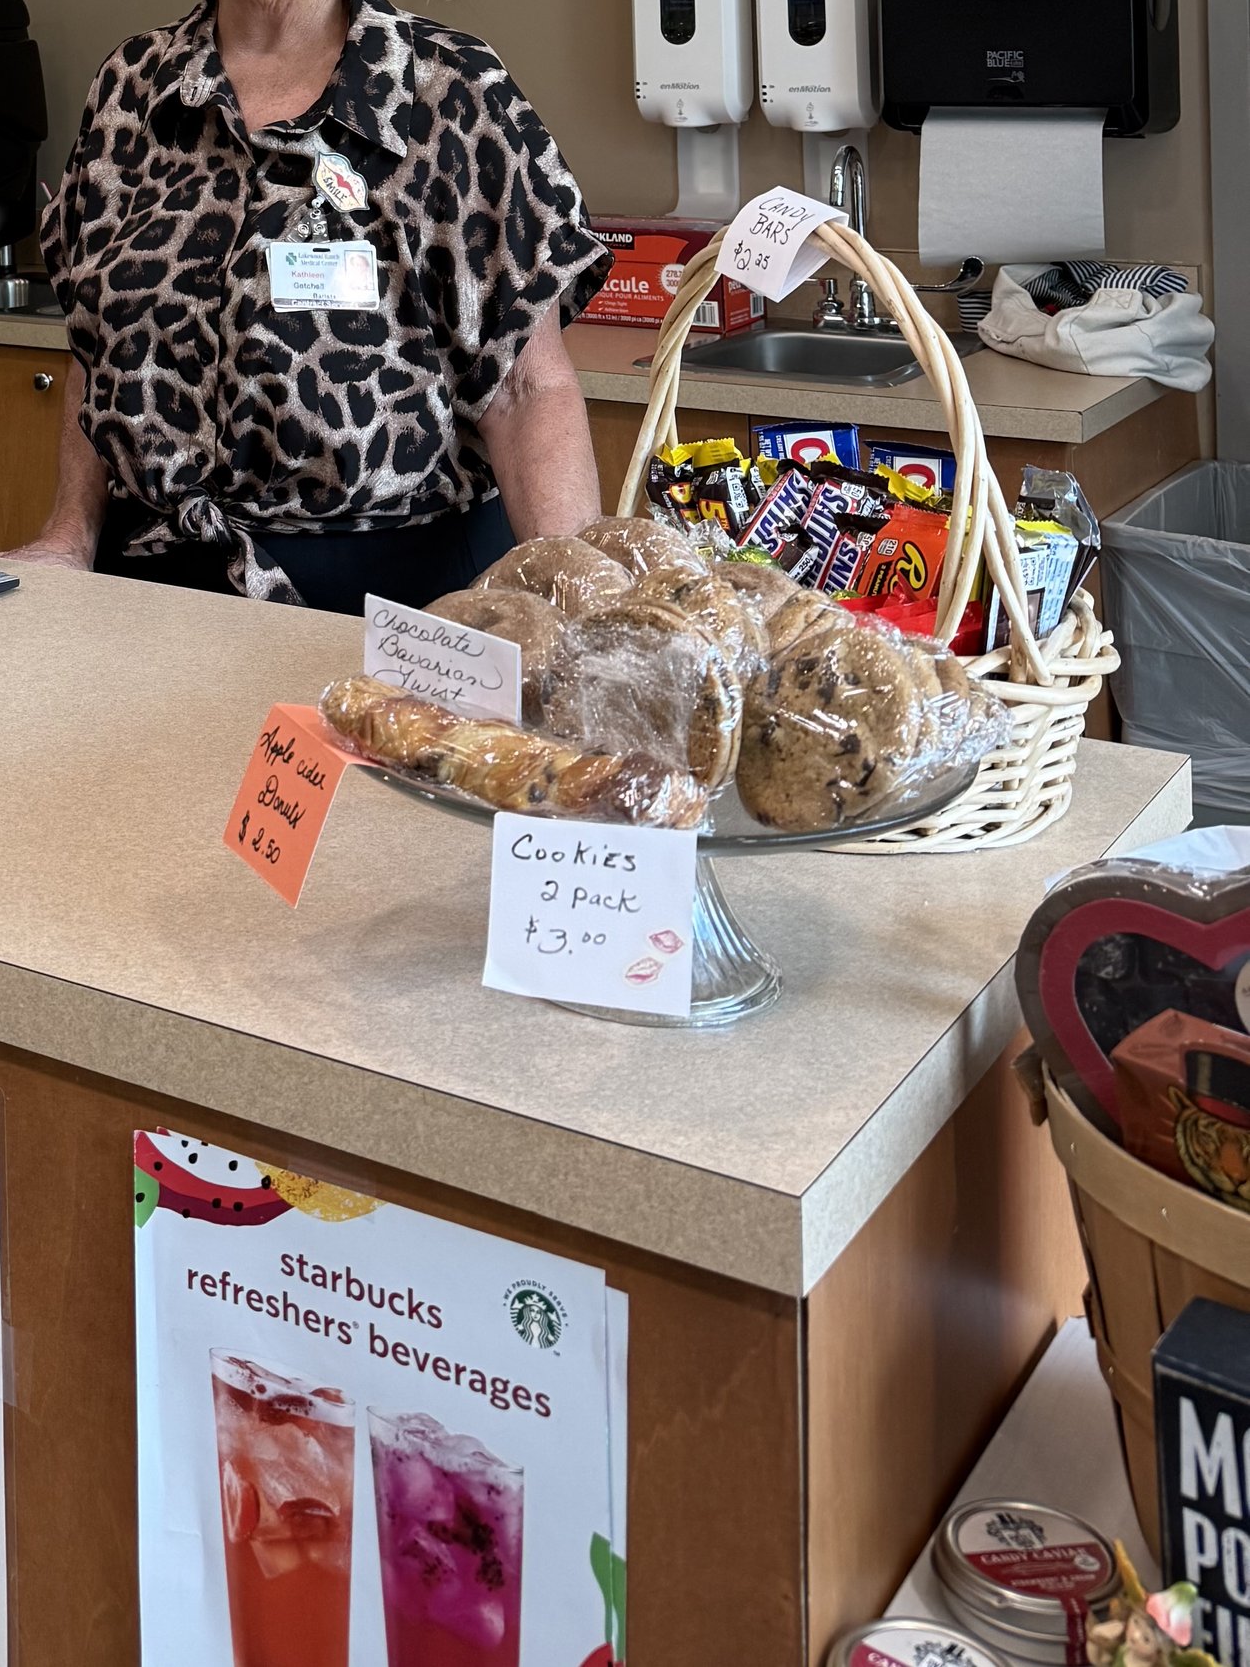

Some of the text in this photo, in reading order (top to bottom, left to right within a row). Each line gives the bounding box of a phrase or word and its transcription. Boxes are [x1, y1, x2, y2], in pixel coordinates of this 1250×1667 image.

[986, 50, 1025, 60] PACIFIC
[987, 59, 1011, 68] BLUE
[660, 82, 700, 91] enMotion
[789, 84, 831, 94] enMotion
[322, 176, 348, 203] SMILE
[750, 213, 791, 245] BARS
[759, 196, 816, 231] CANDY
[615, 293, 665, 302] POUR ALIMENTS
[373, 609, 485, 657] Chocolate
[377, 634, 504, 690] Bavarian
[373, 665, 466, 701] Twist
[260, 725, 327, 791] Apple cider
[257, 774, 307, 830] Donuts
[509, 833, 638, 873] Cookies
[539, 879, 643, 914] 2 pack
[279, 1251, 444, 1331] starbucks
[511, 1279, 547, 1291] PROUDLY
[368, 1328, 552, 1417] beverages
[980, 1553, 1029, 1565] CANDY
